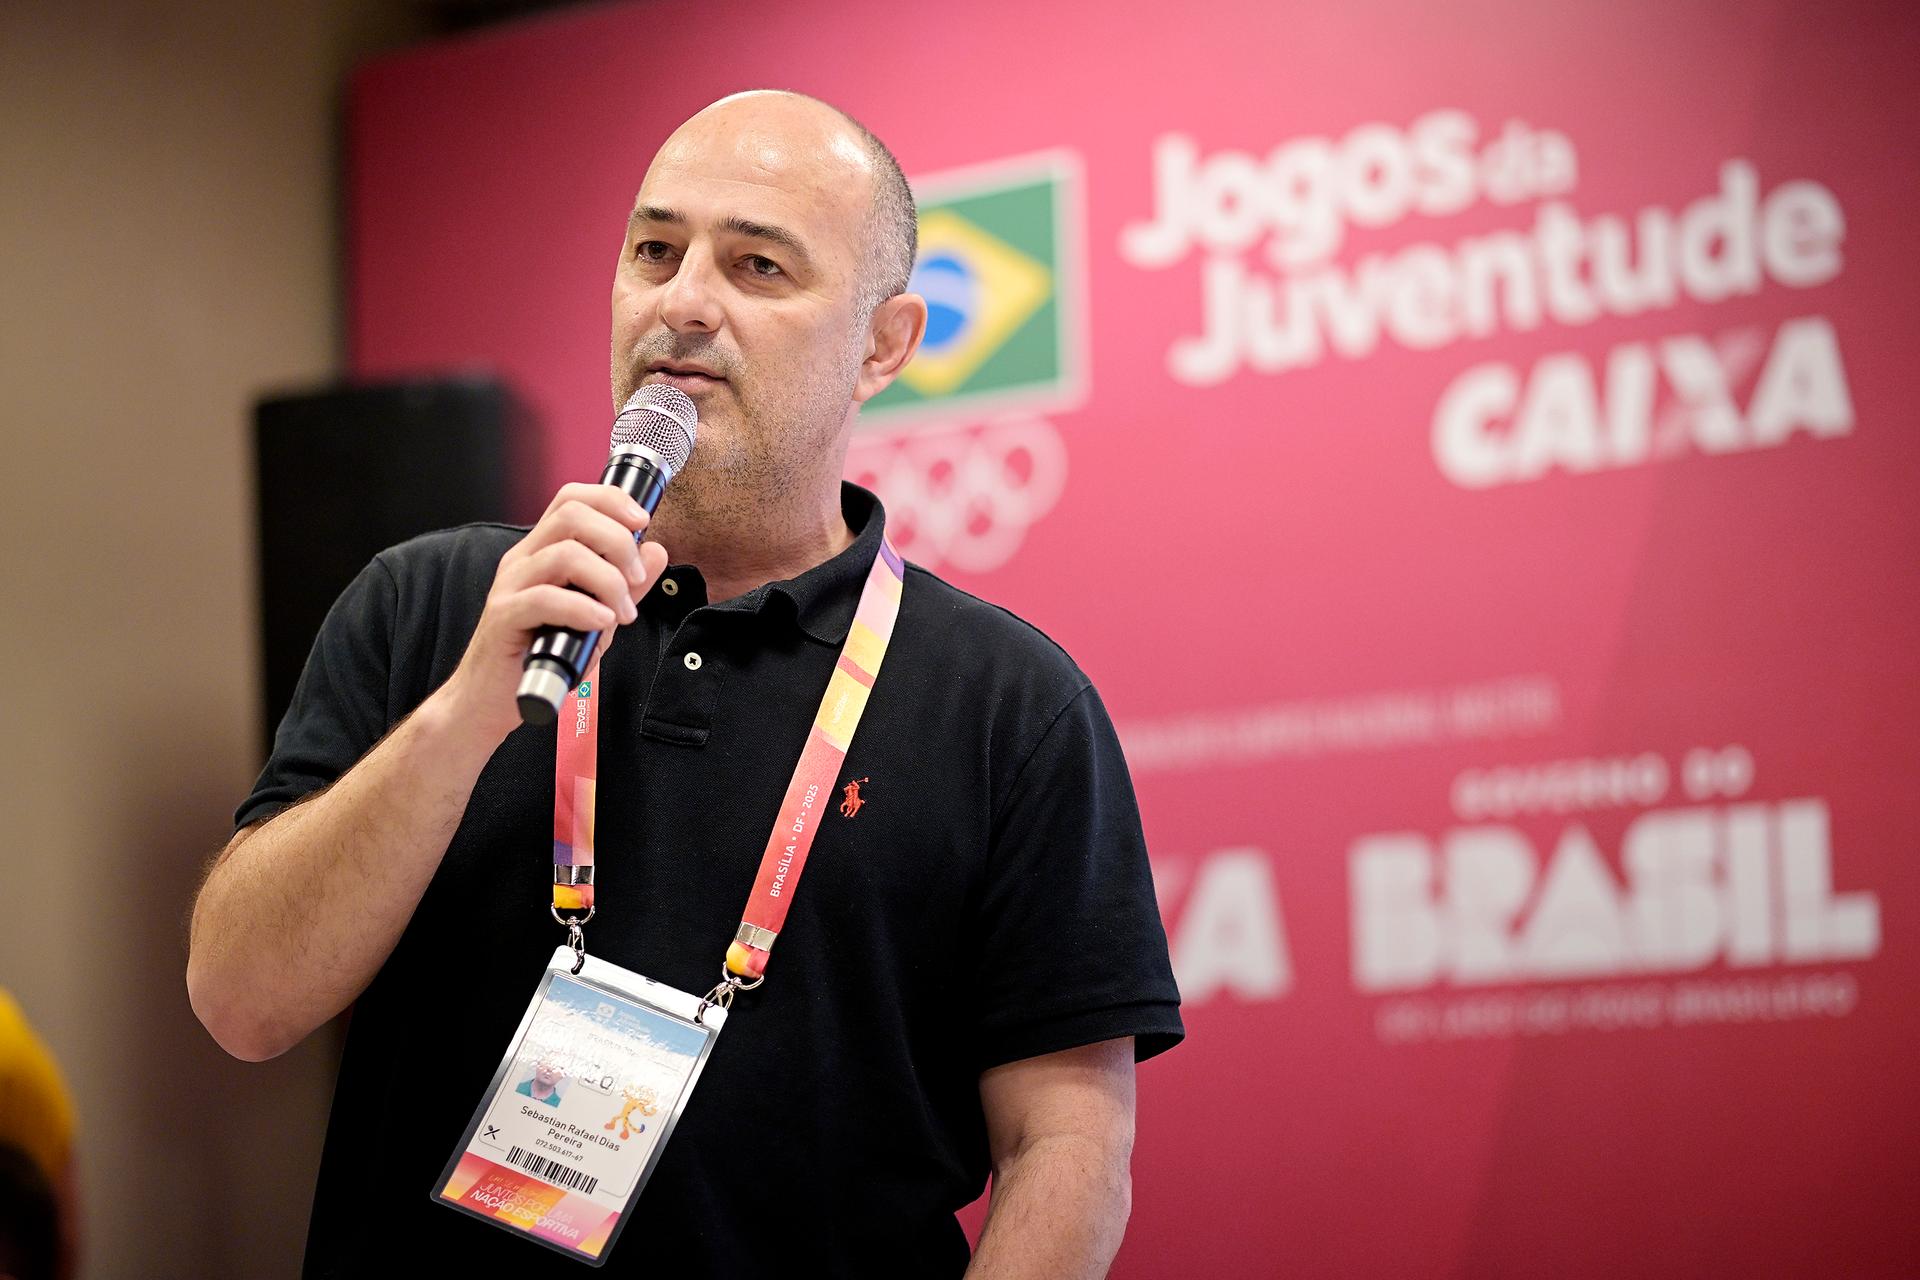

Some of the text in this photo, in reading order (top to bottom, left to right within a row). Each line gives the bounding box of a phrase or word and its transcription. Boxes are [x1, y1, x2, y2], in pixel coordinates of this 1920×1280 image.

[1120, 110, 1577, 268] Jogos da
[1168, 157, 1846, 385] Juventude
[1431, 314, 1855, 488] CAIXA
[576, 700, 586, 738] BRASIL
[1454, 745, 1754, 819] GOVERNO DO
[770, 784, 819, 897] BRASÍLIA DF 2025
[1349, 799, 1881, 993] BRASIL
[520, 1105, 621, 1152] Sebastian Rafael Dias
[547, 1128, 583, 1149] Pereira
[470, 1189, 579, 1240] NAÇÃO ESPORTIVA
[480, 1183, 525, 1205] JUNTOS
